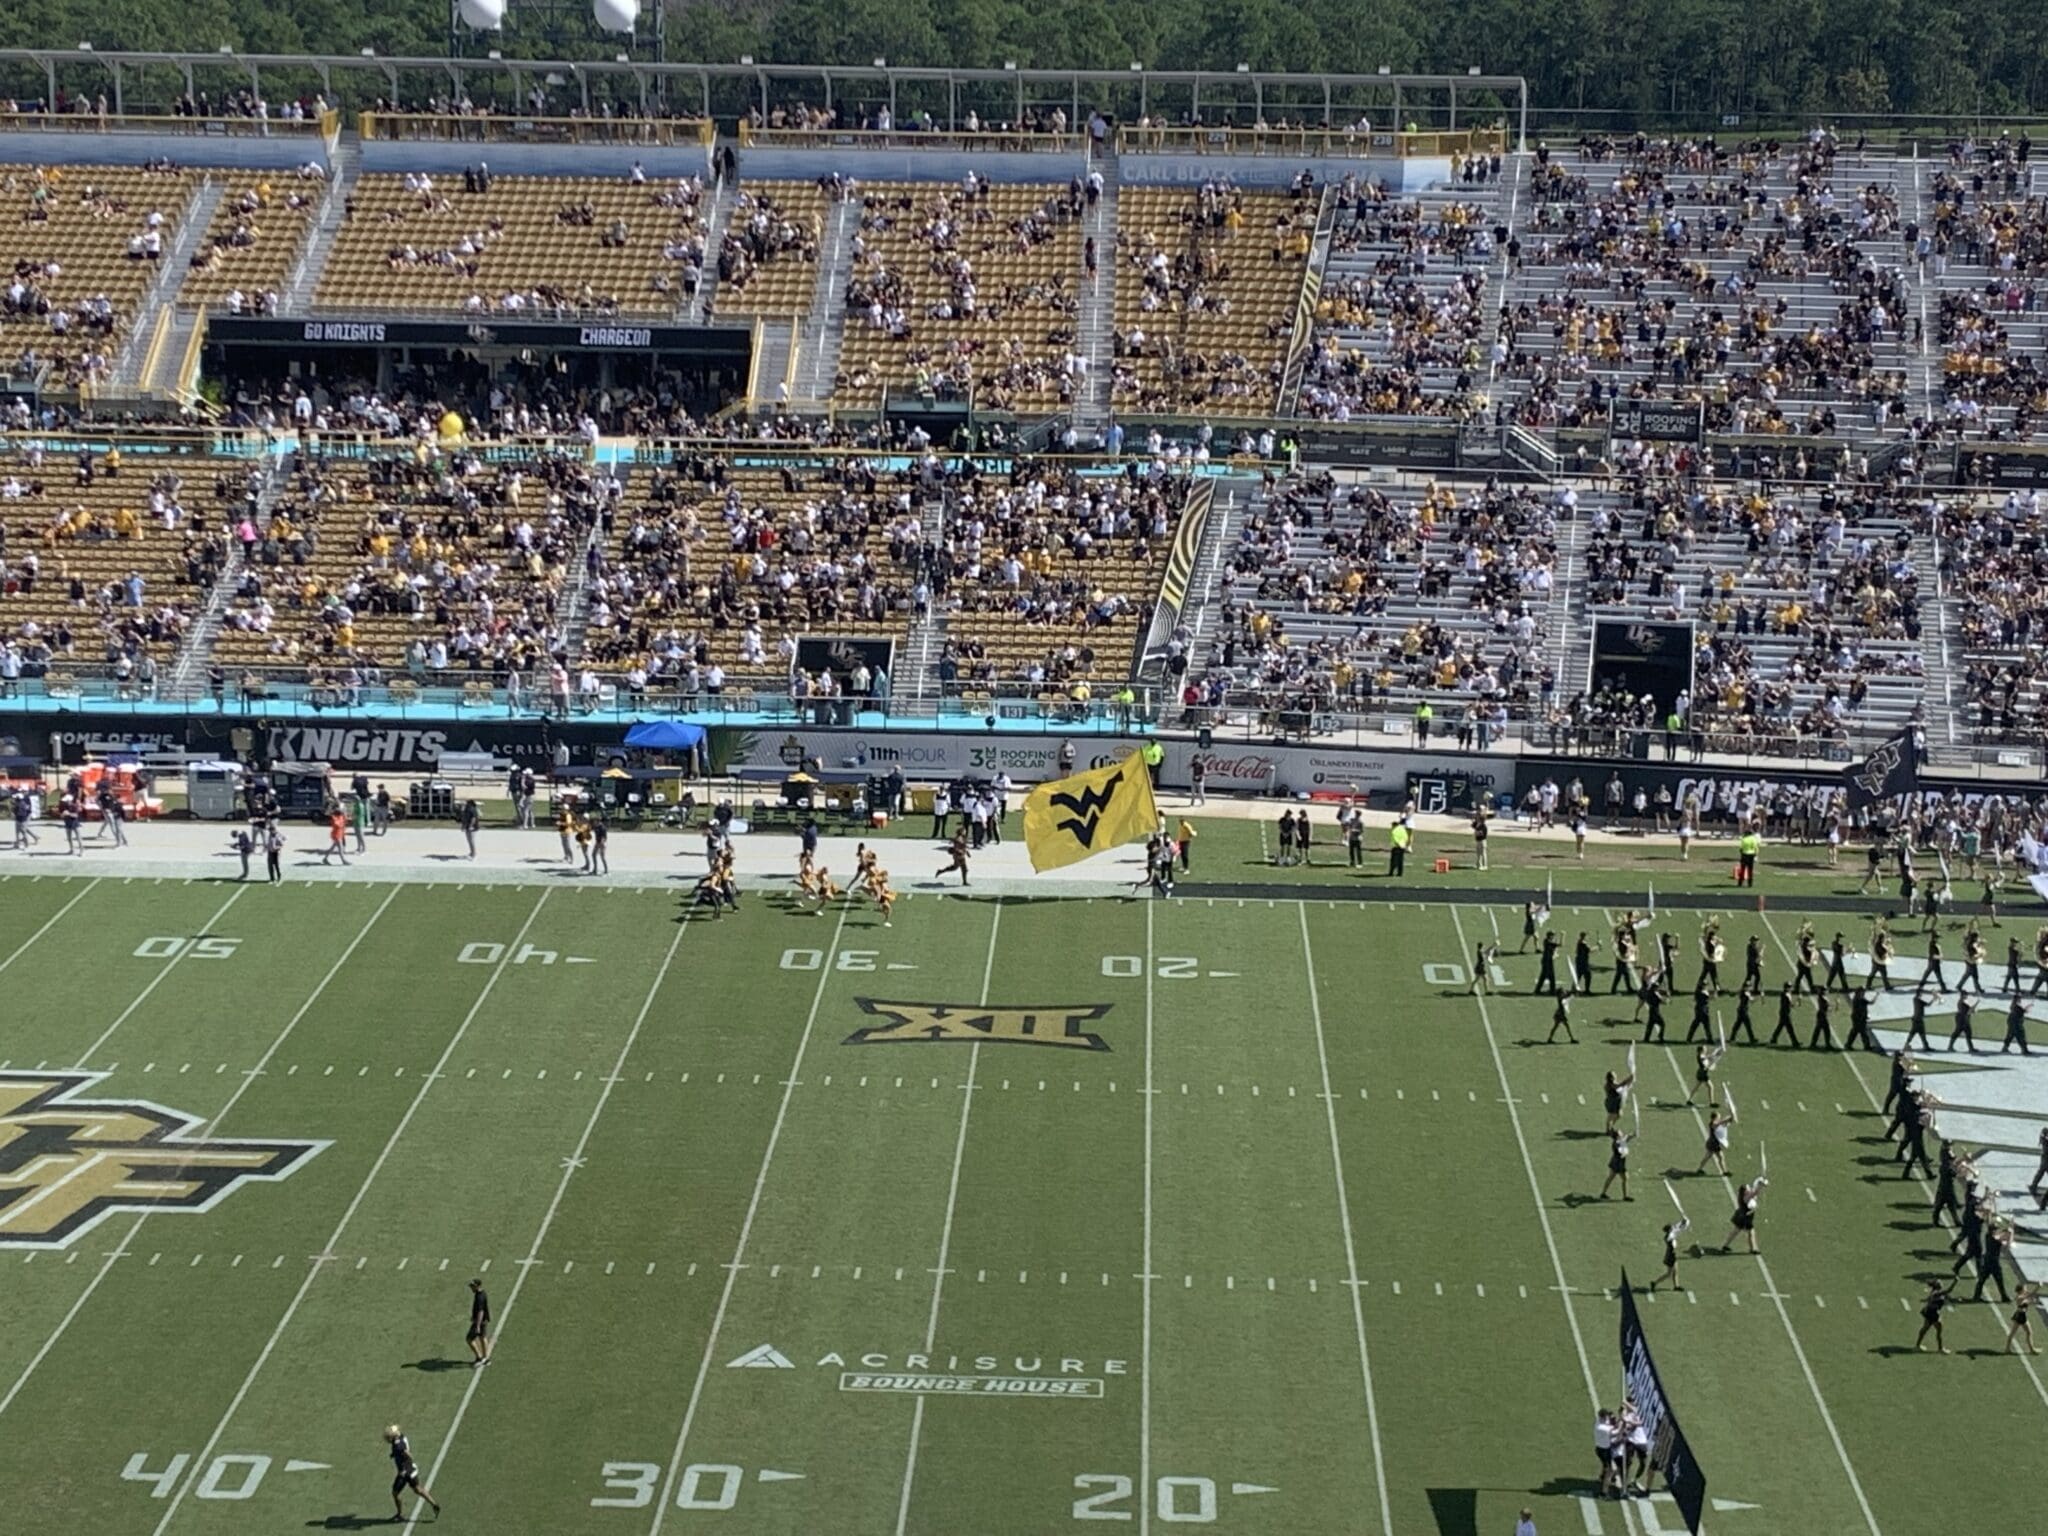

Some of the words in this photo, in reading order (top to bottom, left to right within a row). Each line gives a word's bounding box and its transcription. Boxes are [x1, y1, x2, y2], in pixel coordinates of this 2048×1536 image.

[1123, 165, 1171, 180] CARL
[304, 322, 323, 340] GO
[324, 323, 386, 341] KNIGHTS
[1644, 414, 1697, 425] ROOFING
[1651, 423, 1687, 433] SOLAR
[737, 701, 758, 712] 130
[1005, 706, 1023, 718] 131
[1320, 718, 1341, 731] 132
[267, 726, 447, 763] KNIGHTS
[1000, 750, 1056, 761] ROOFING
[1007, 759, 1046, 769] SOLAR
[132, 935, 244, 960] 50
[456, 942, 560, 965] 40
[778, 948, 881, 973] 30
[1101, 956, 1199, 979] 20
[817, 1352, 1129, 1376] ACRISURE
[850, 1375, 978, 1392] BOUNCE
[987, 1377, 1091, 1395] HOUSE
[119, 1452, 273, 1501] 40
[589, 1461, 744, 1512] 30
[1071, 1473, 1219, 1524] 20
